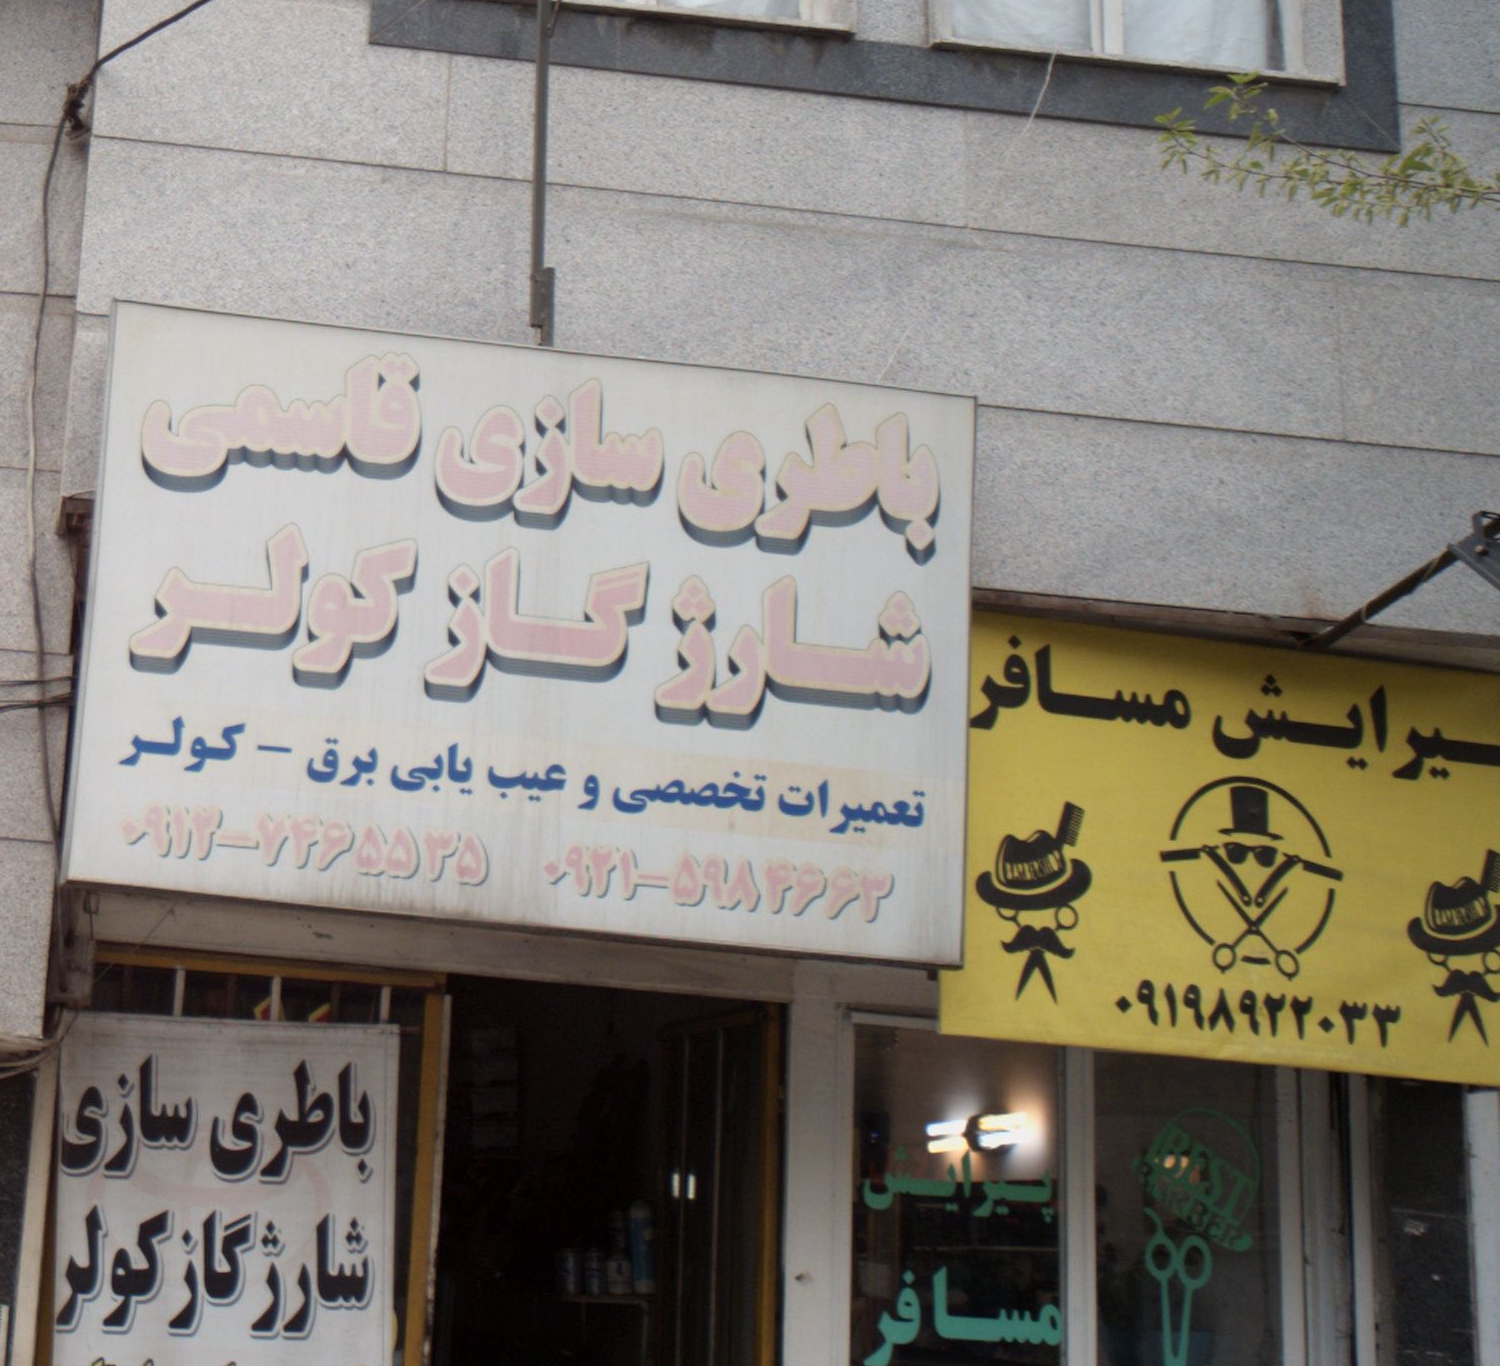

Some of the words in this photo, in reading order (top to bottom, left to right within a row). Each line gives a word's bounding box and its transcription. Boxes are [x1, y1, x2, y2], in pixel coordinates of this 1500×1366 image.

[141, 351, 421, 492] قاسمی
[435, 378, 664, 530] سازی
[678, 403, 940, 565] باطری
[129, 523, 417, 690] کولر
[424, 546, 649, 702] گاز
[655, 575, 932, 730] شارژ
[118, 716, 246, 772] کولر
[970, 636, 1192, 729] مسافر
[1213, 674, 1500, 781] یرایش
[306, 736, 379, 786] برق
[390, 742, 473, 795] یابی
[488, 764, 567, 802] عیب
[578, 774, 600, 809] و
[612, 771, 767, 813] تخصصی
[778, 779, 926, 834] تعمیرات
[1115, 979, 1401, 1048] ۰۹۱۹۸۹۲۲۰۳۳
[60, 1055, 197, 1177] سازی
[210, 1060, 374, 1182] باطری
[863, 1146, 1055, 1223] پیرایش
